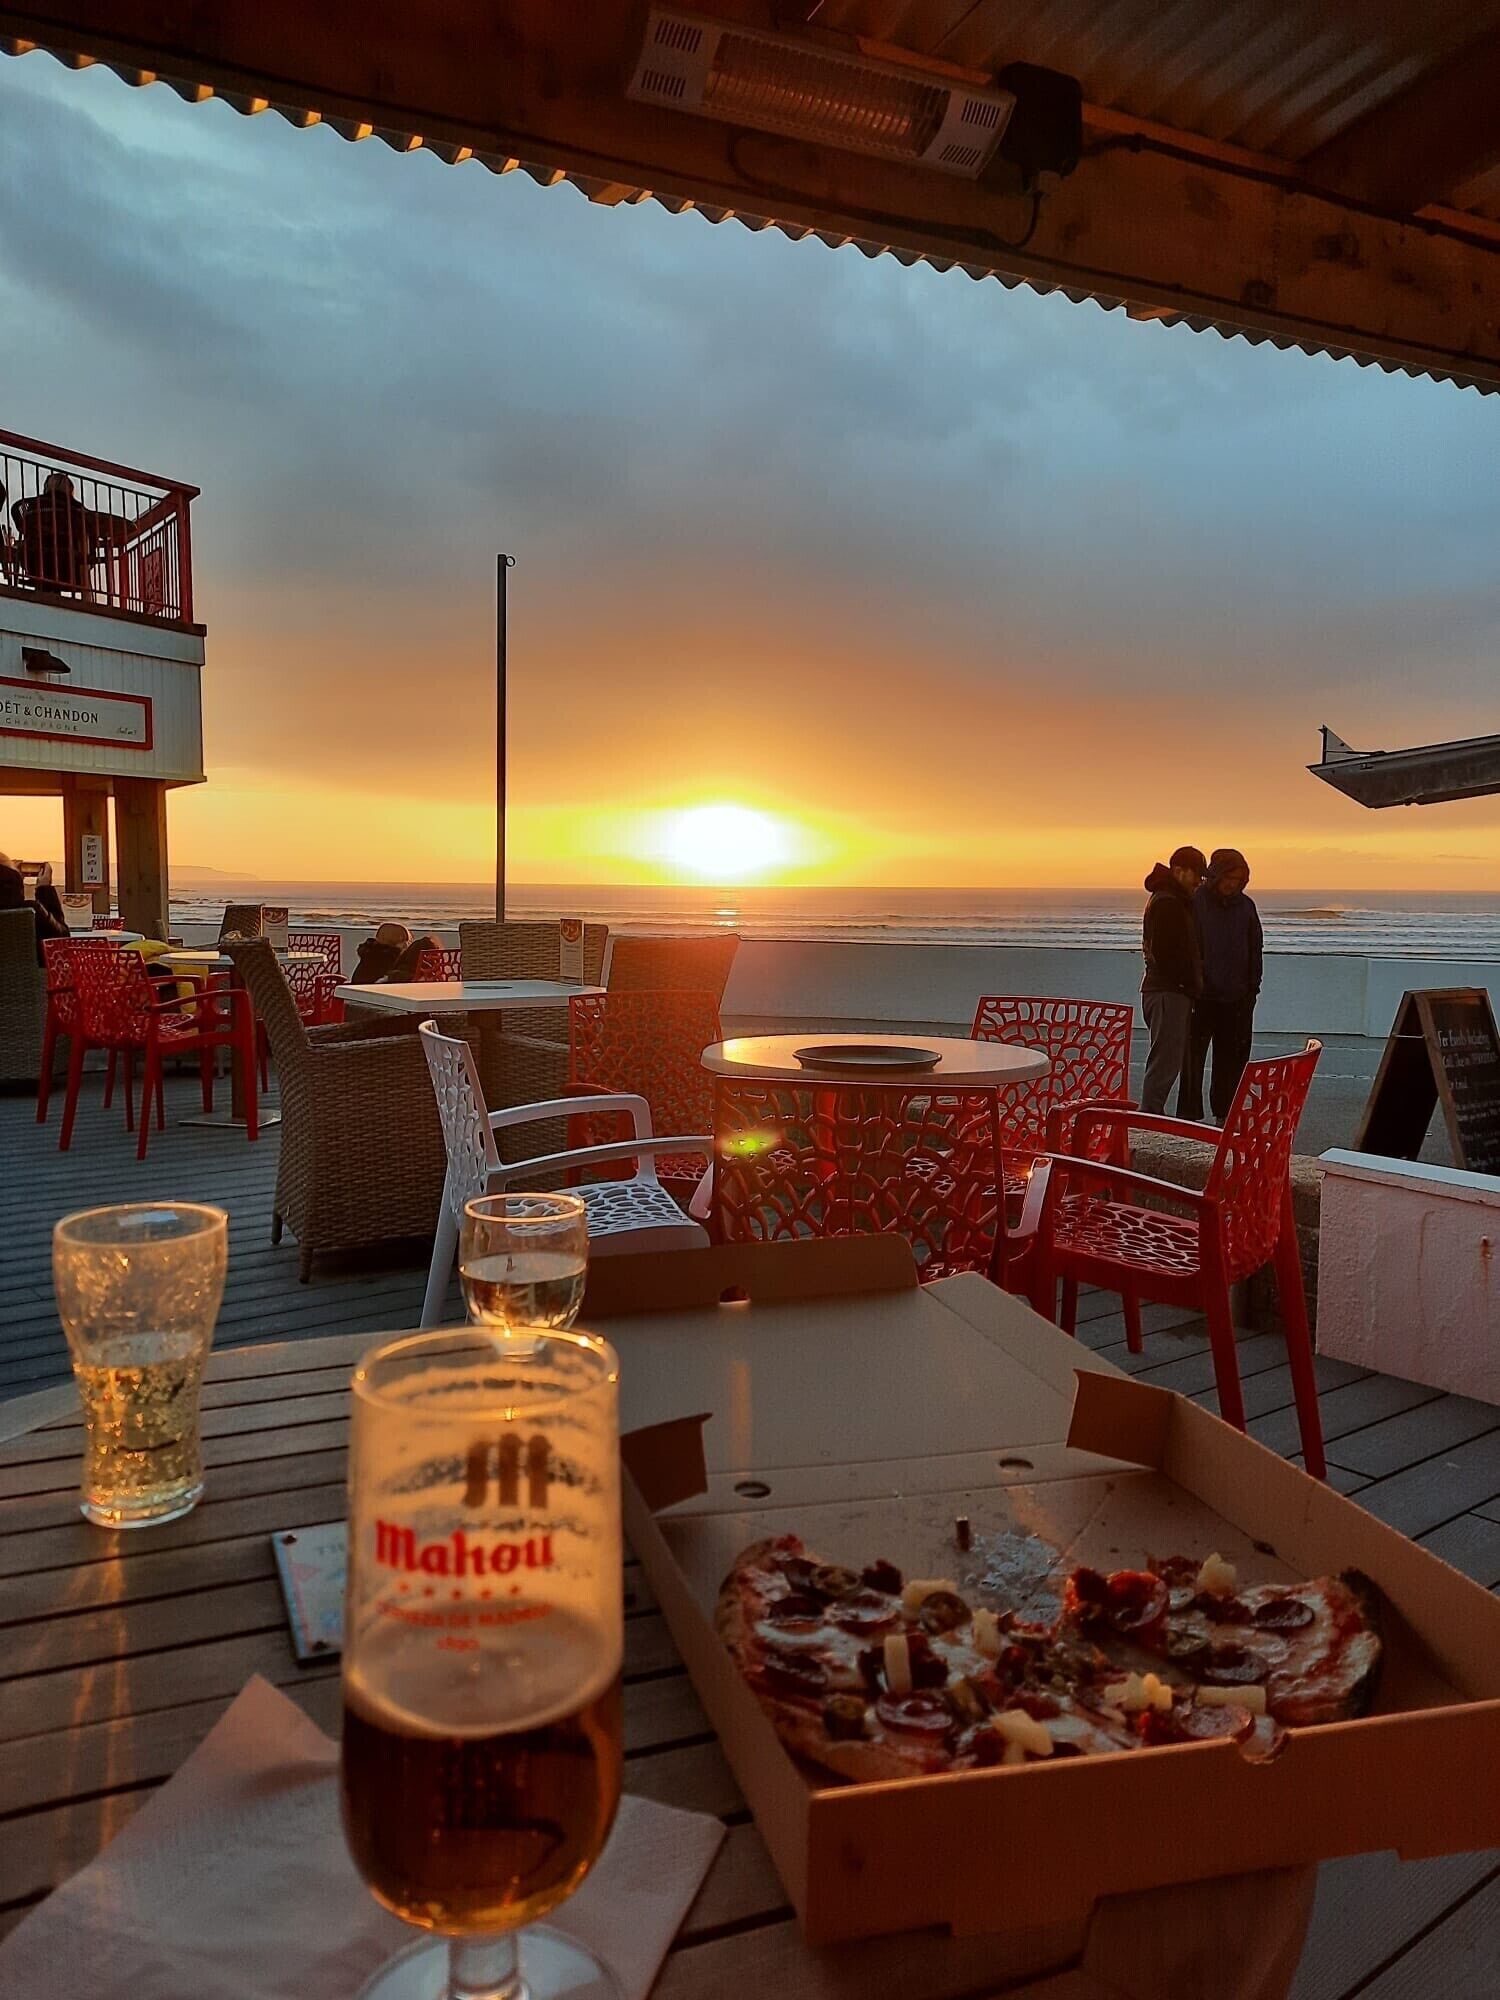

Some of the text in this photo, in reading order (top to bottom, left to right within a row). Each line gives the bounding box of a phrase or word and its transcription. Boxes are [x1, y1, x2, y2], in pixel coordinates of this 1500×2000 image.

[24, 706, 32, 717] &
[34, 705, 98, 724] CHANDON
[5, 717, 79, 732] CHAMPAGNE
[375, 1519, 554, 1578] Mahou
